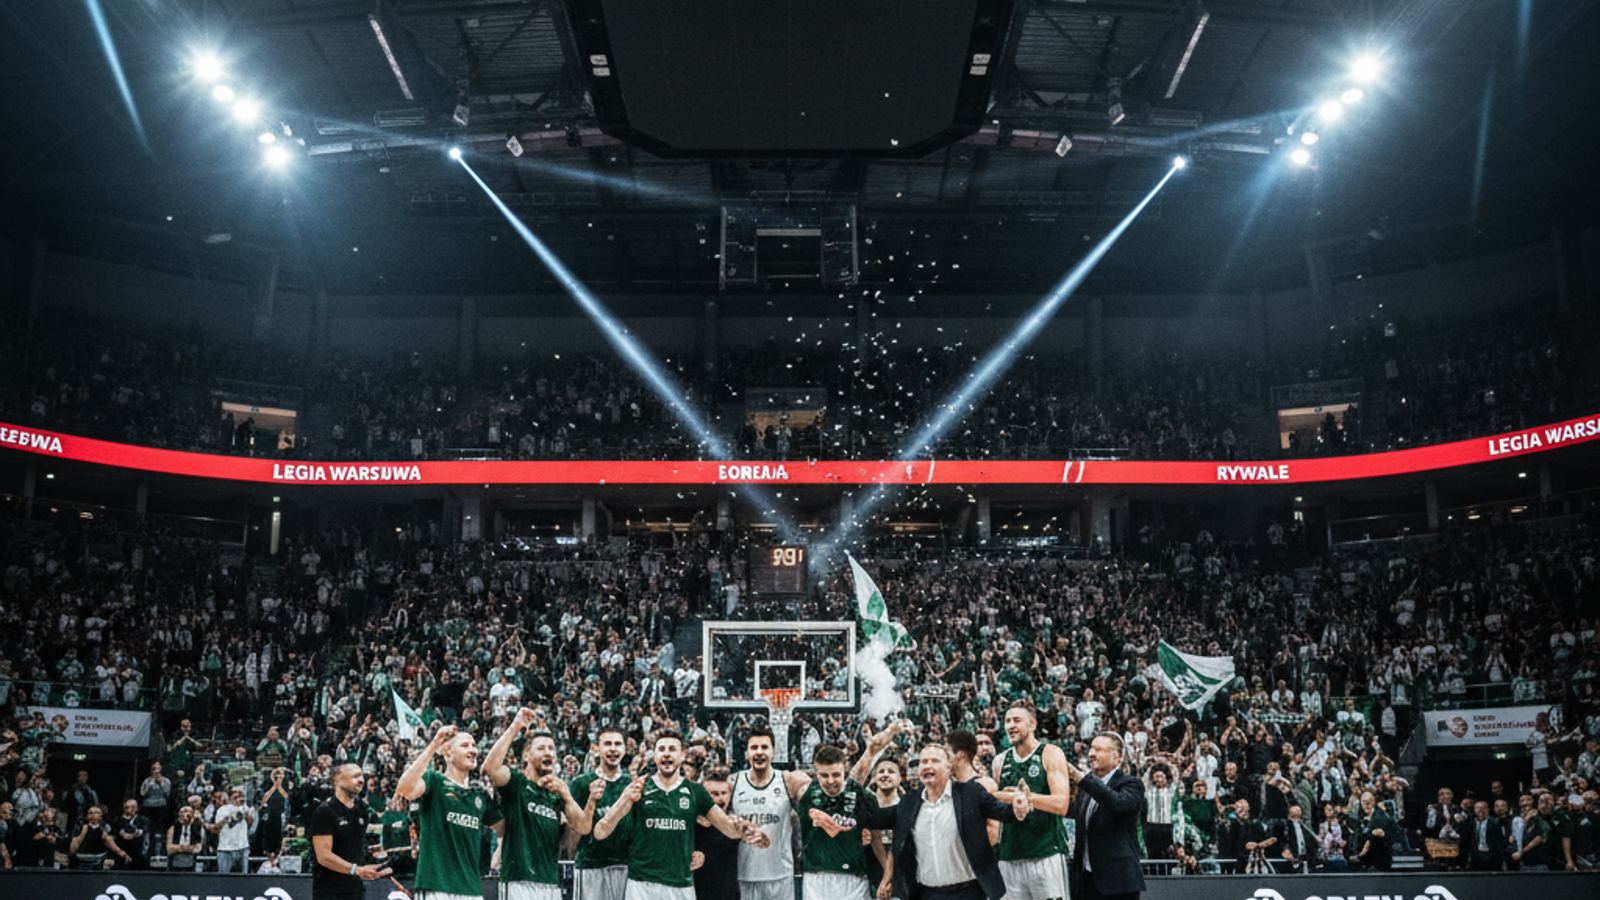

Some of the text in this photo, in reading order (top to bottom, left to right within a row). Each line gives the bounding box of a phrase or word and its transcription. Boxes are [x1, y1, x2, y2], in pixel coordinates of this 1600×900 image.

[1488, 433, 1543, 456] LEGIA
[272, 464, 326, 480] LEGIA
[1216, 465, 1290, 481] RYWALE
